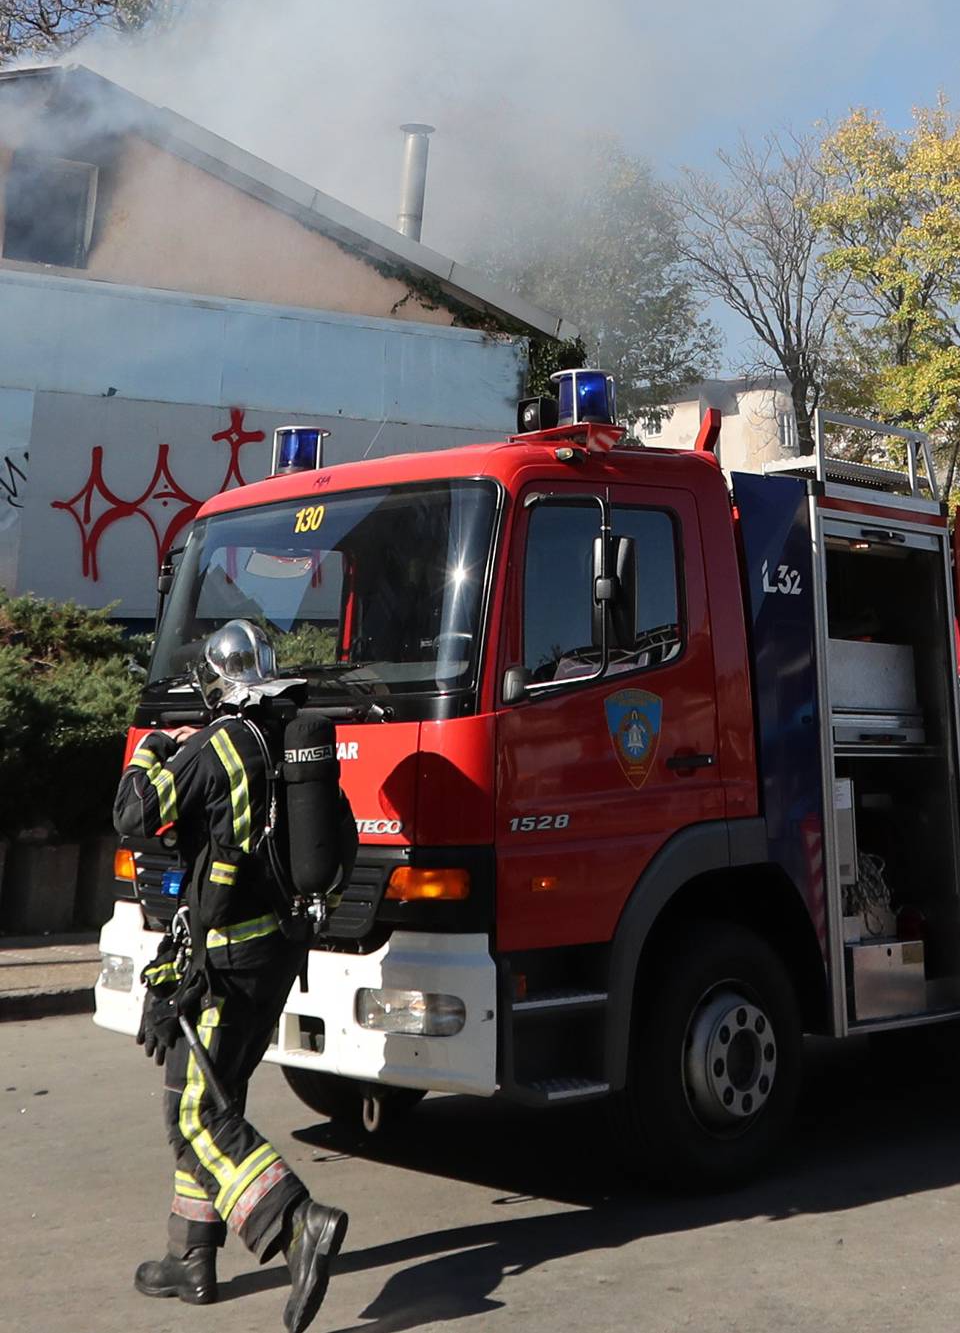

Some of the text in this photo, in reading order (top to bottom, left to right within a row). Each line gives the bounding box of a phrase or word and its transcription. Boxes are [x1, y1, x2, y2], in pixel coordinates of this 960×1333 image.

[295, 505, 325, 534] 130
[761, 558, 802, 595] L32
[299, 745, 333, 762] MSA
[336, 741, 359, 761] AR
[509, 814, 569, 832] 1528
